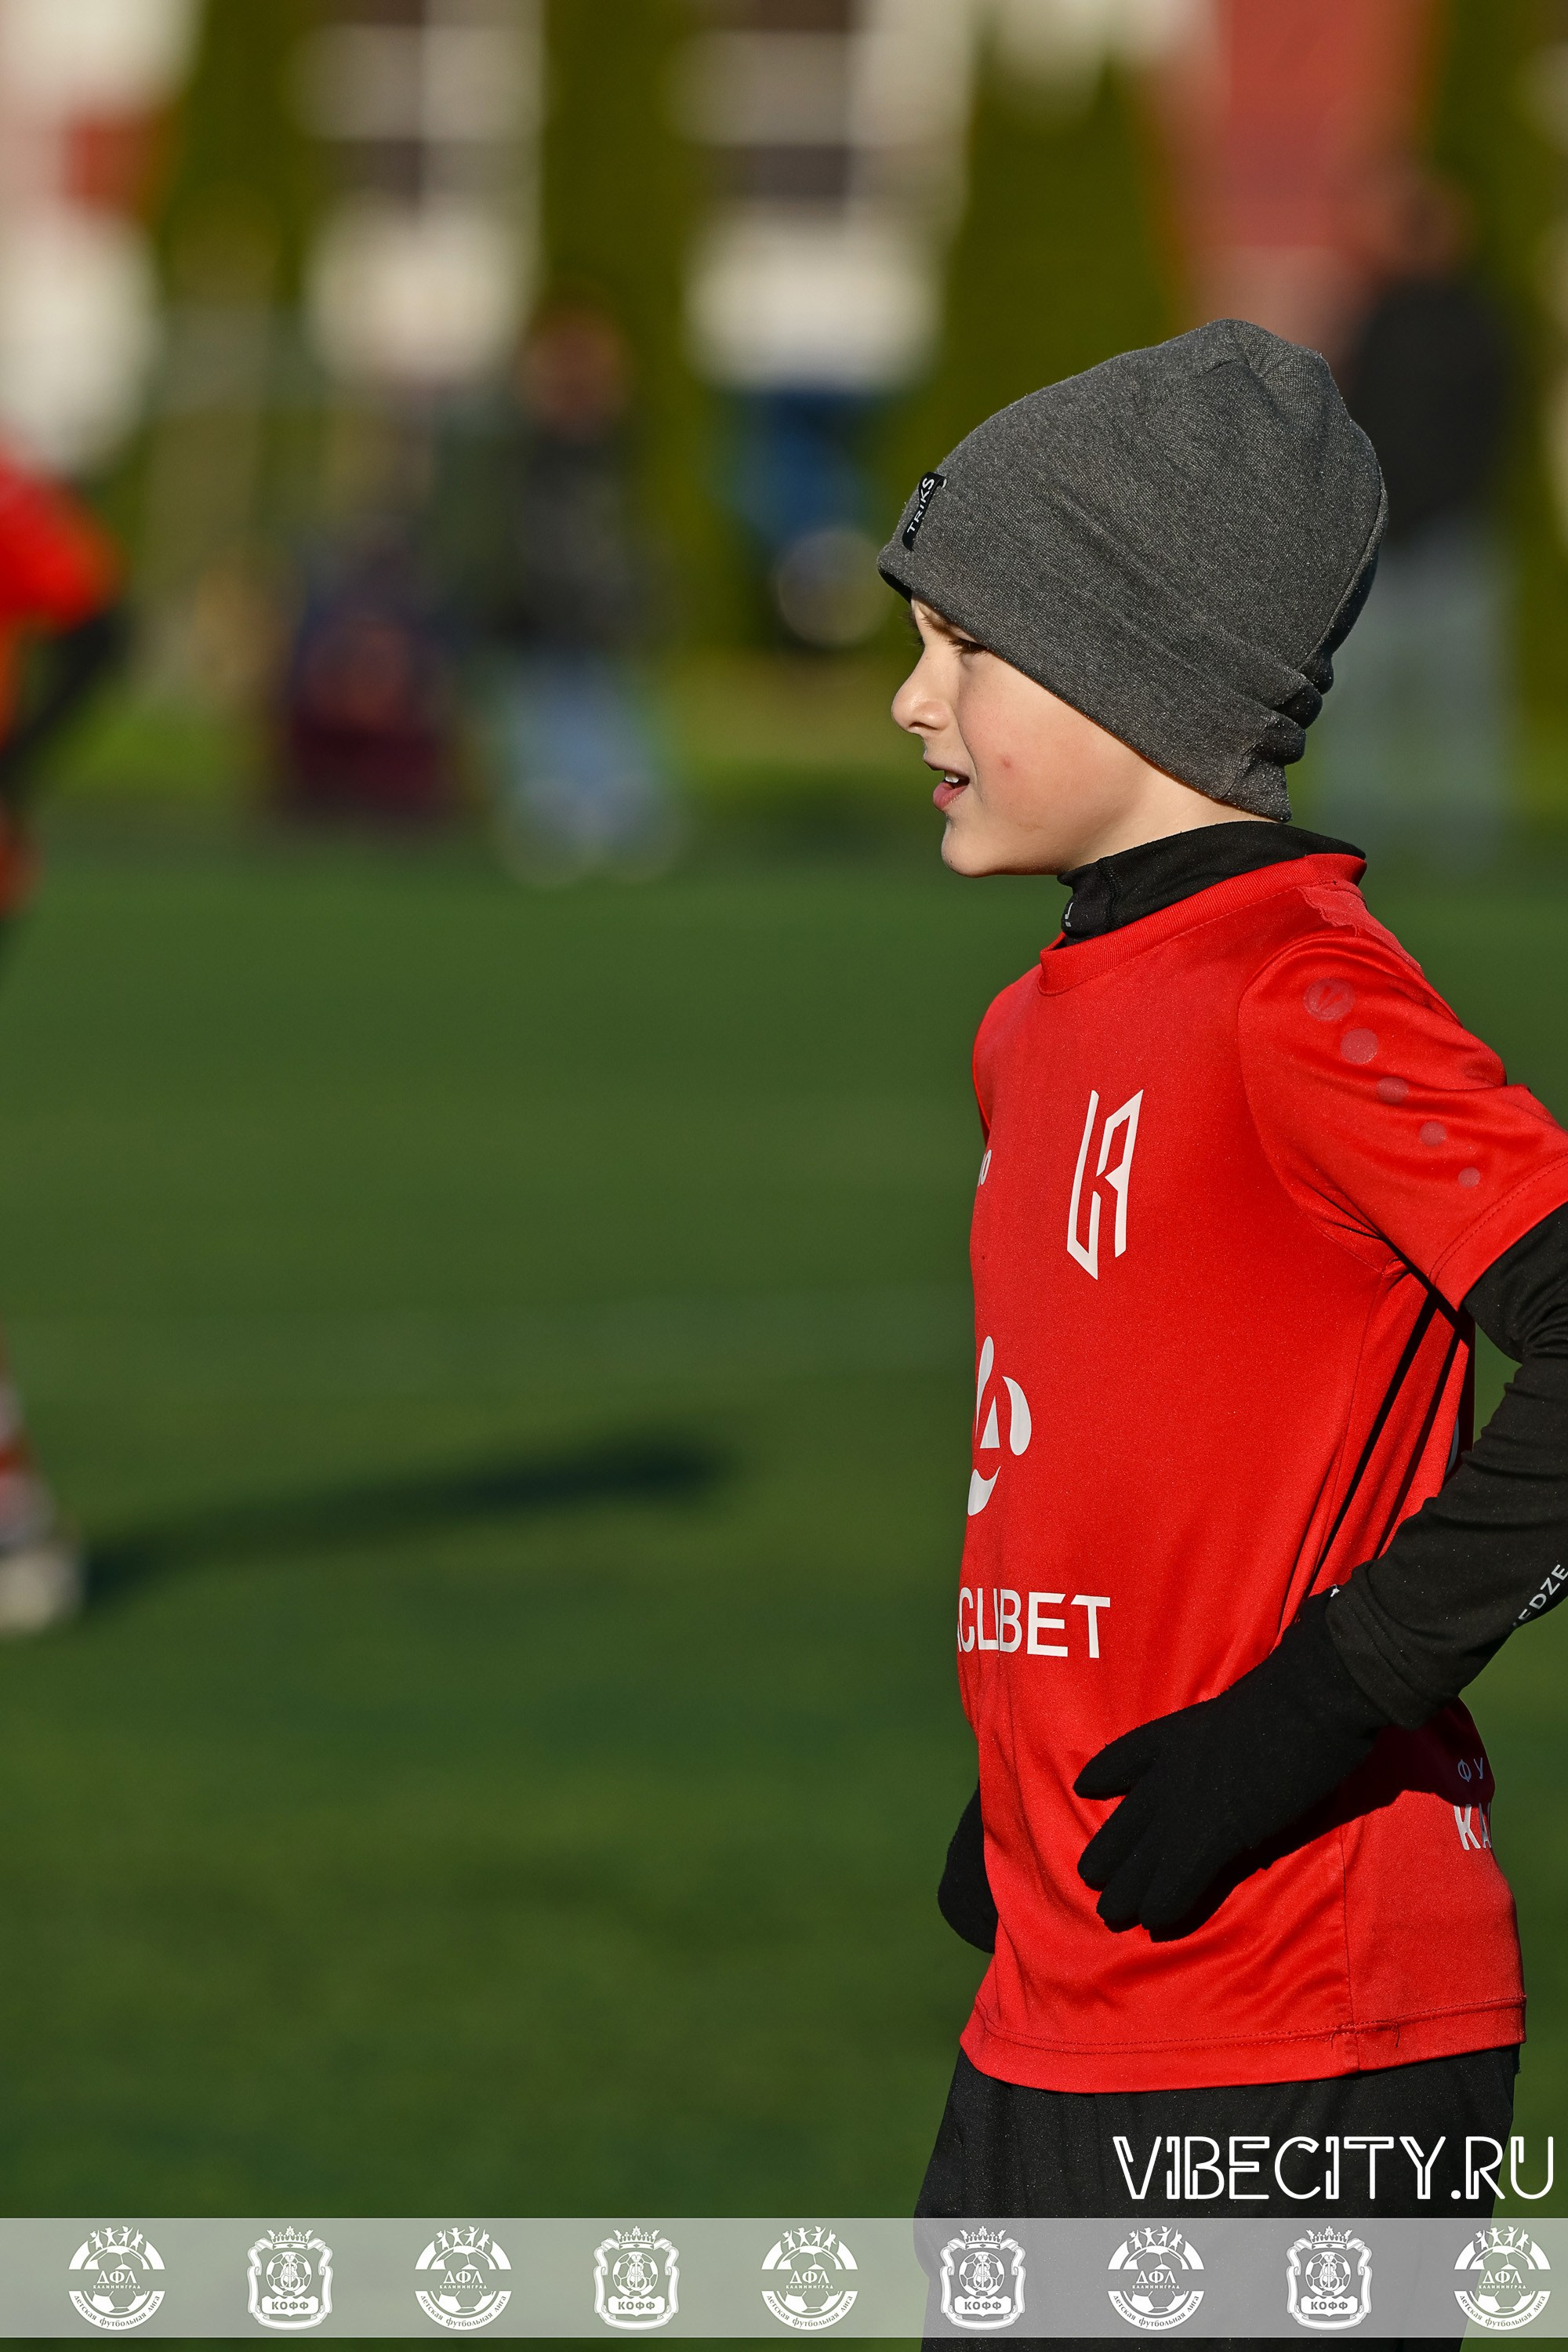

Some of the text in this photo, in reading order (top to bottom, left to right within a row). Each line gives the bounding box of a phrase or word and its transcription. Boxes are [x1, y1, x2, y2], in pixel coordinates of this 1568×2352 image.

[906, 477, 935, 533] TRIKS
[1512, 1564, 1568, 1627] EDZE
[1453, 1802, 1492, 1851] КА
